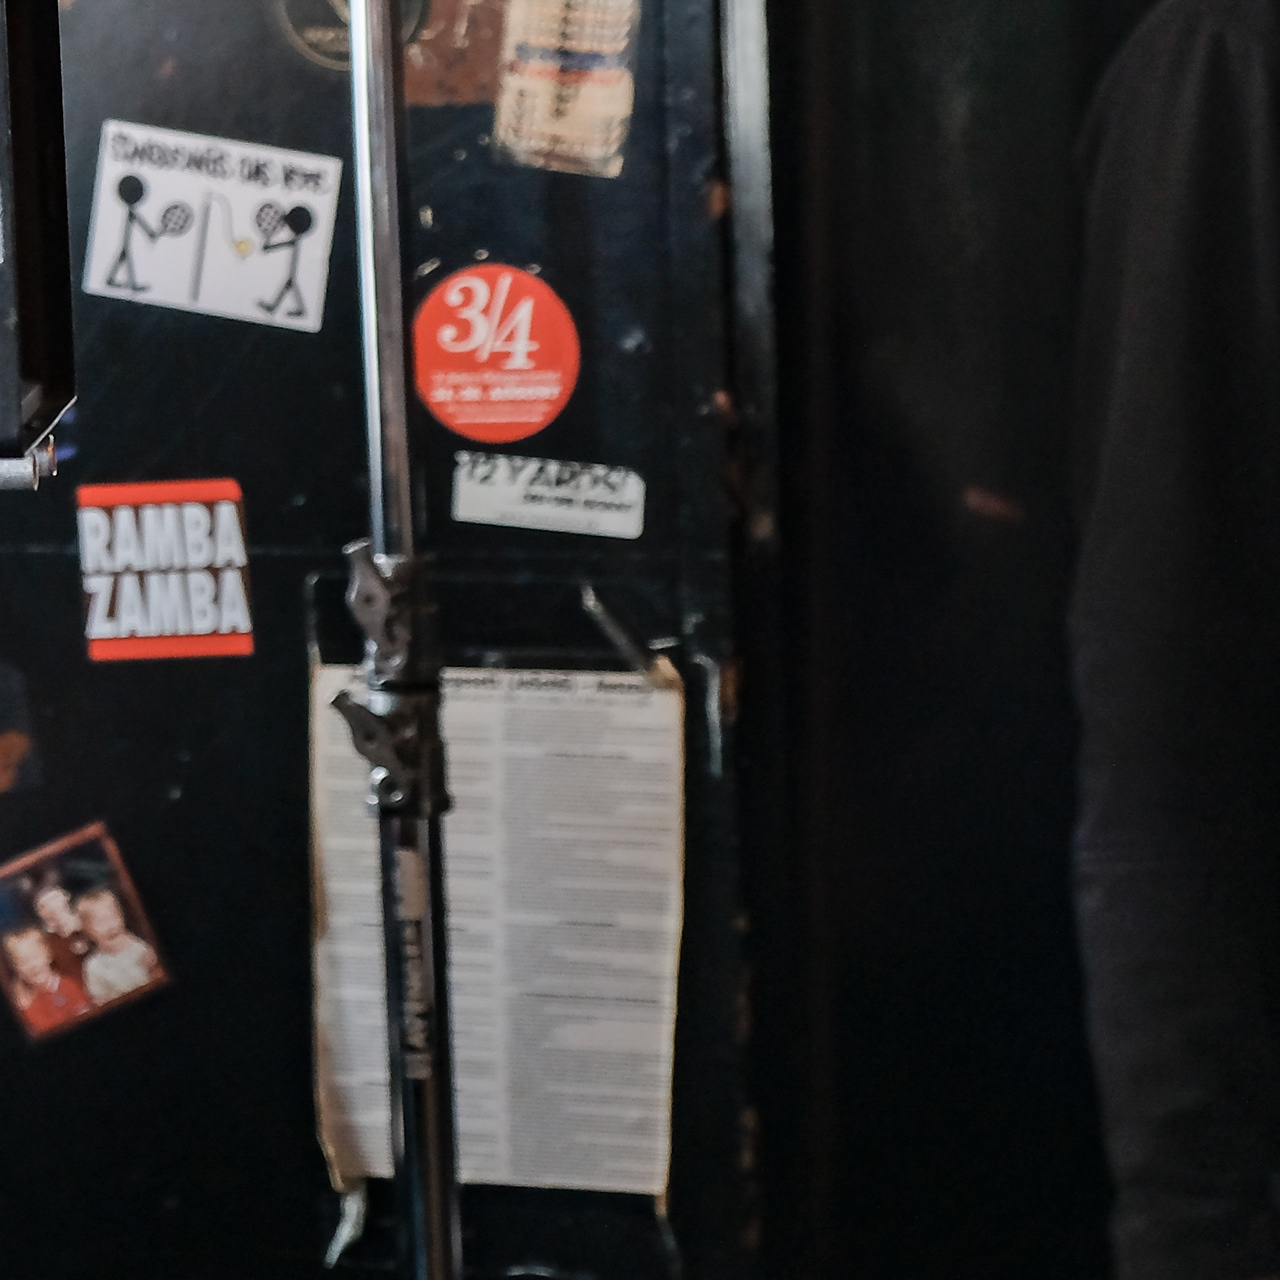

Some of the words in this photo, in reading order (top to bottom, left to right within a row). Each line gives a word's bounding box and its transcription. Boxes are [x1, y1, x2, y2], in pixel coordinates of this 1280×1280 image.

[437, 272, 541, 371] 3/4
[77, 500, 248, 573] RAMBA
[83, 567, 253, 639] ZAMBA
